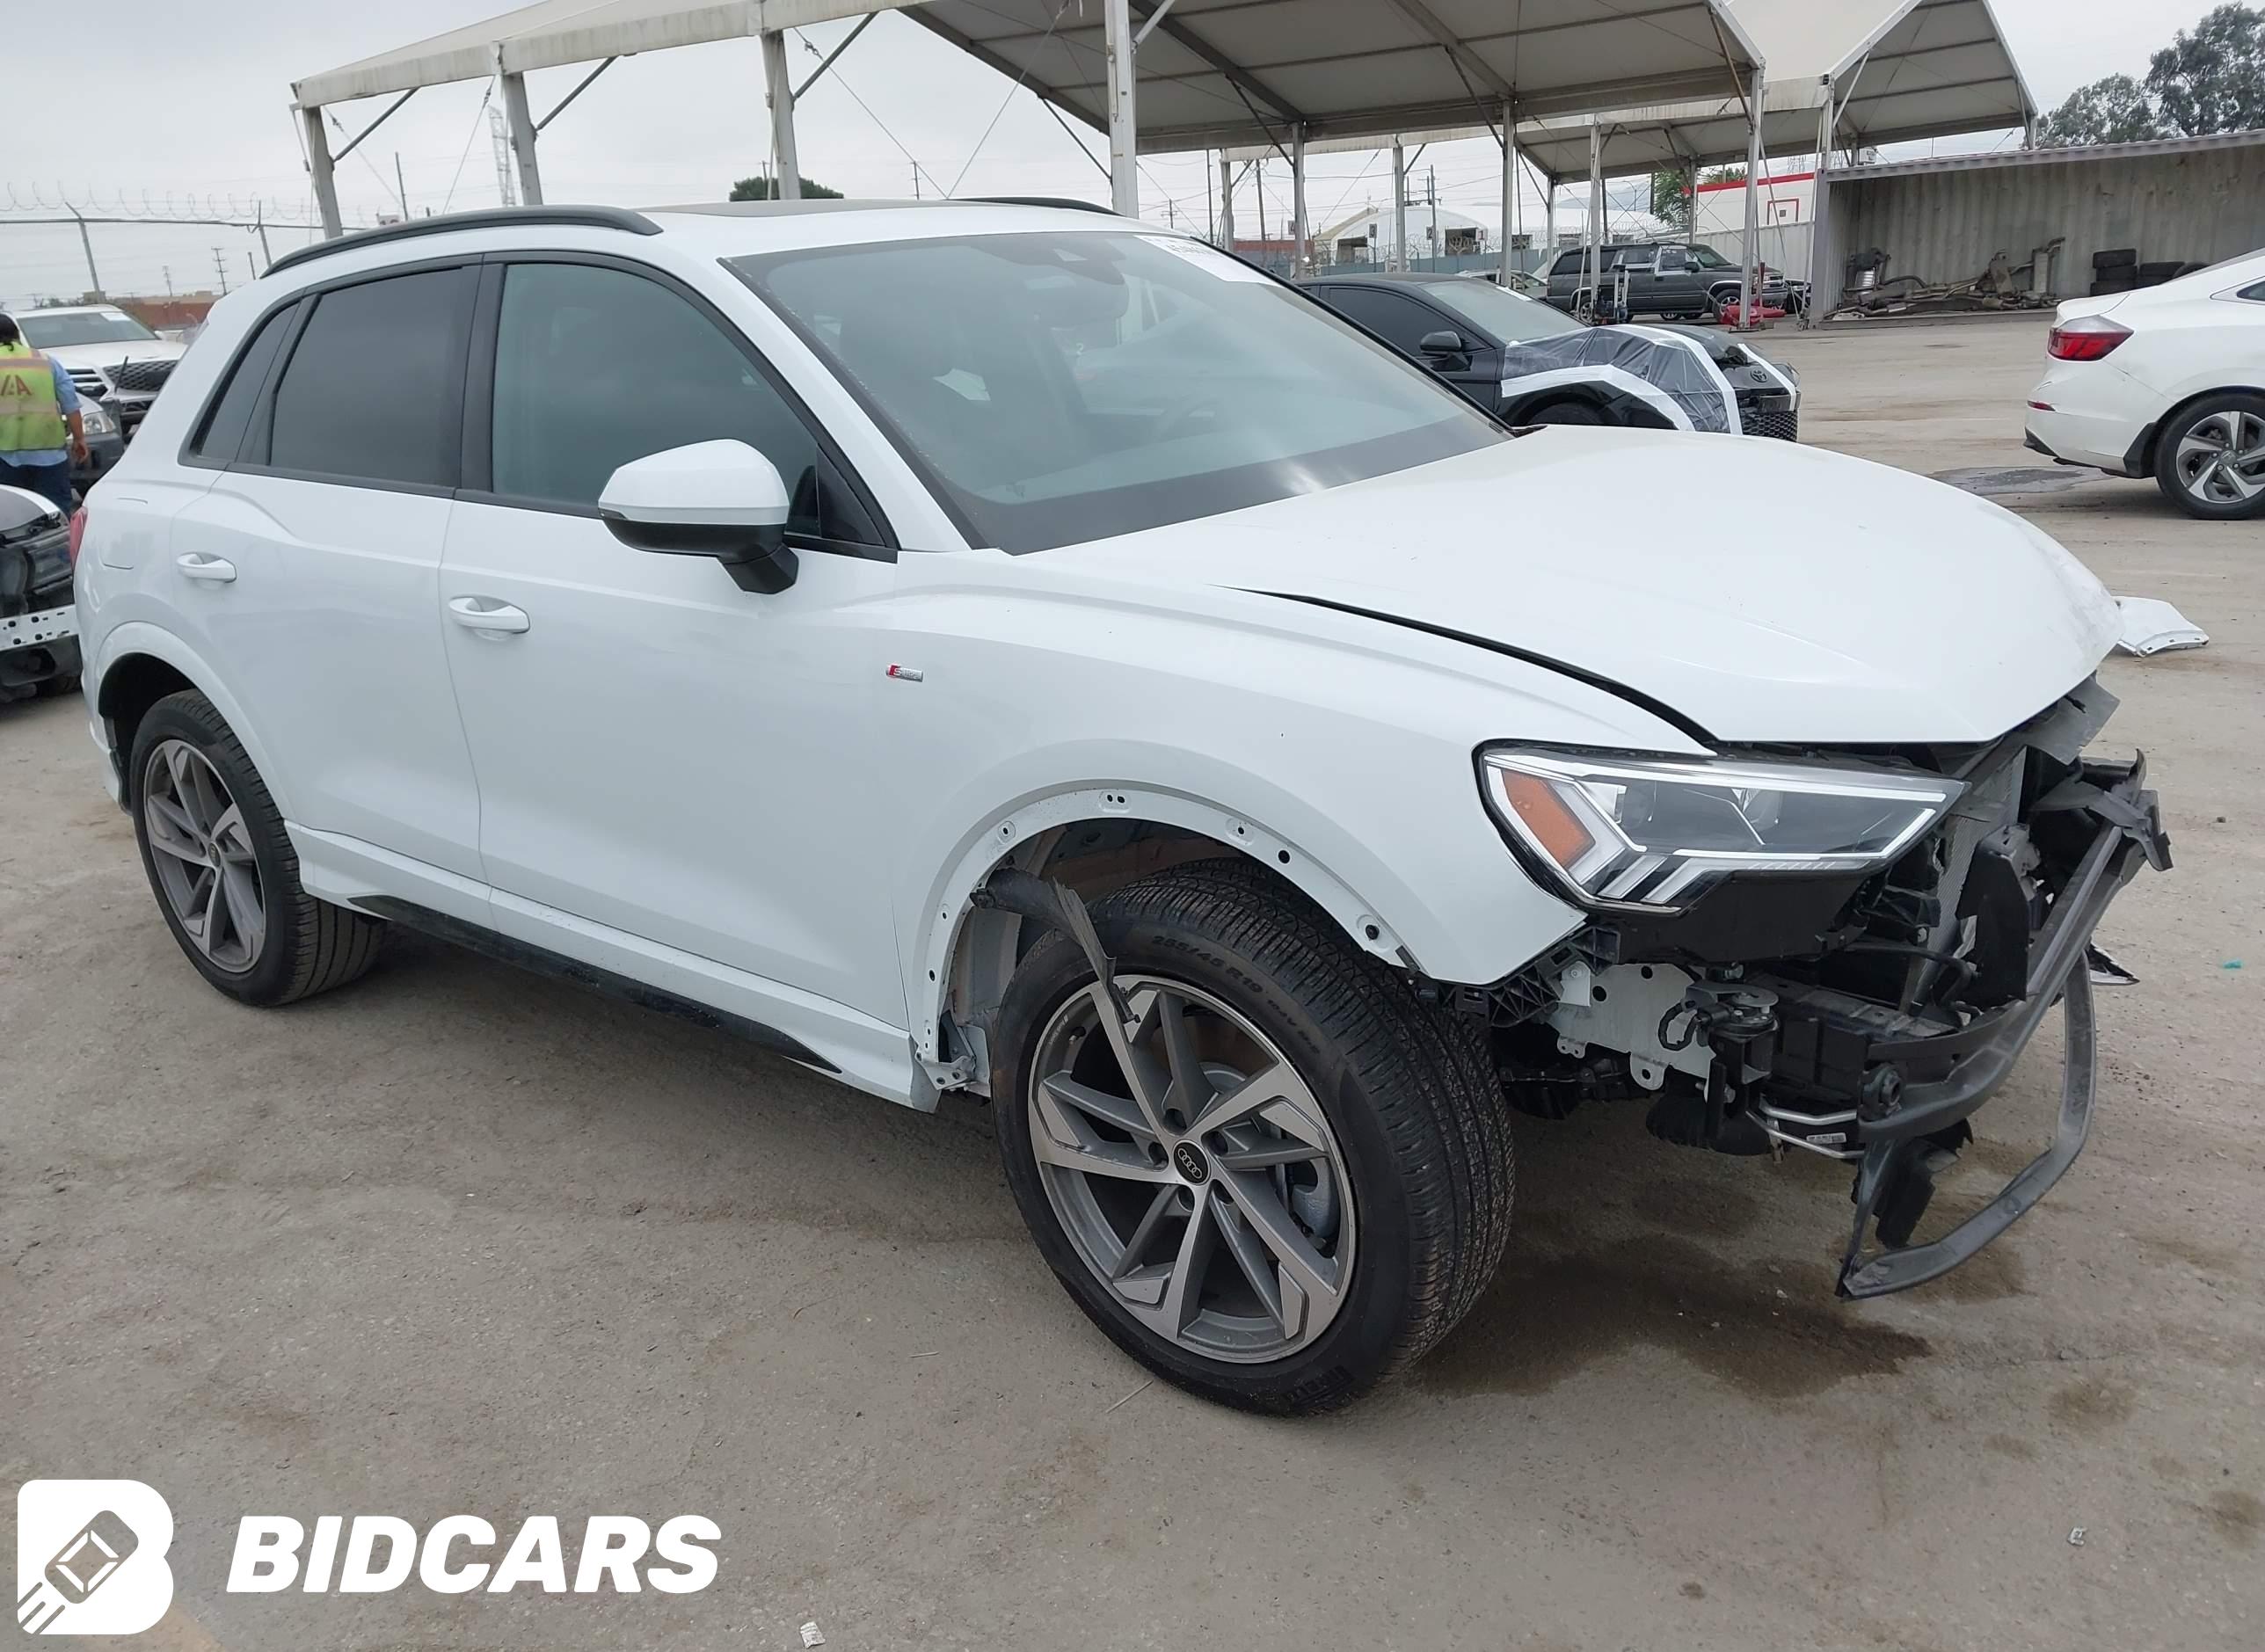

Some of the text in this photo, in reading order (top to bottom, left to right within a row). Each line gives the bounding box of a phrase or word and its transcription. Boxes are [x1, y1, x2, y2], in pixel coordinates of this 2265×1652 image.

[1427, 229, 1433, 239] 2
[1478, 229, 1485, 240] 1
[1226, 967, 1264, 993] R19
